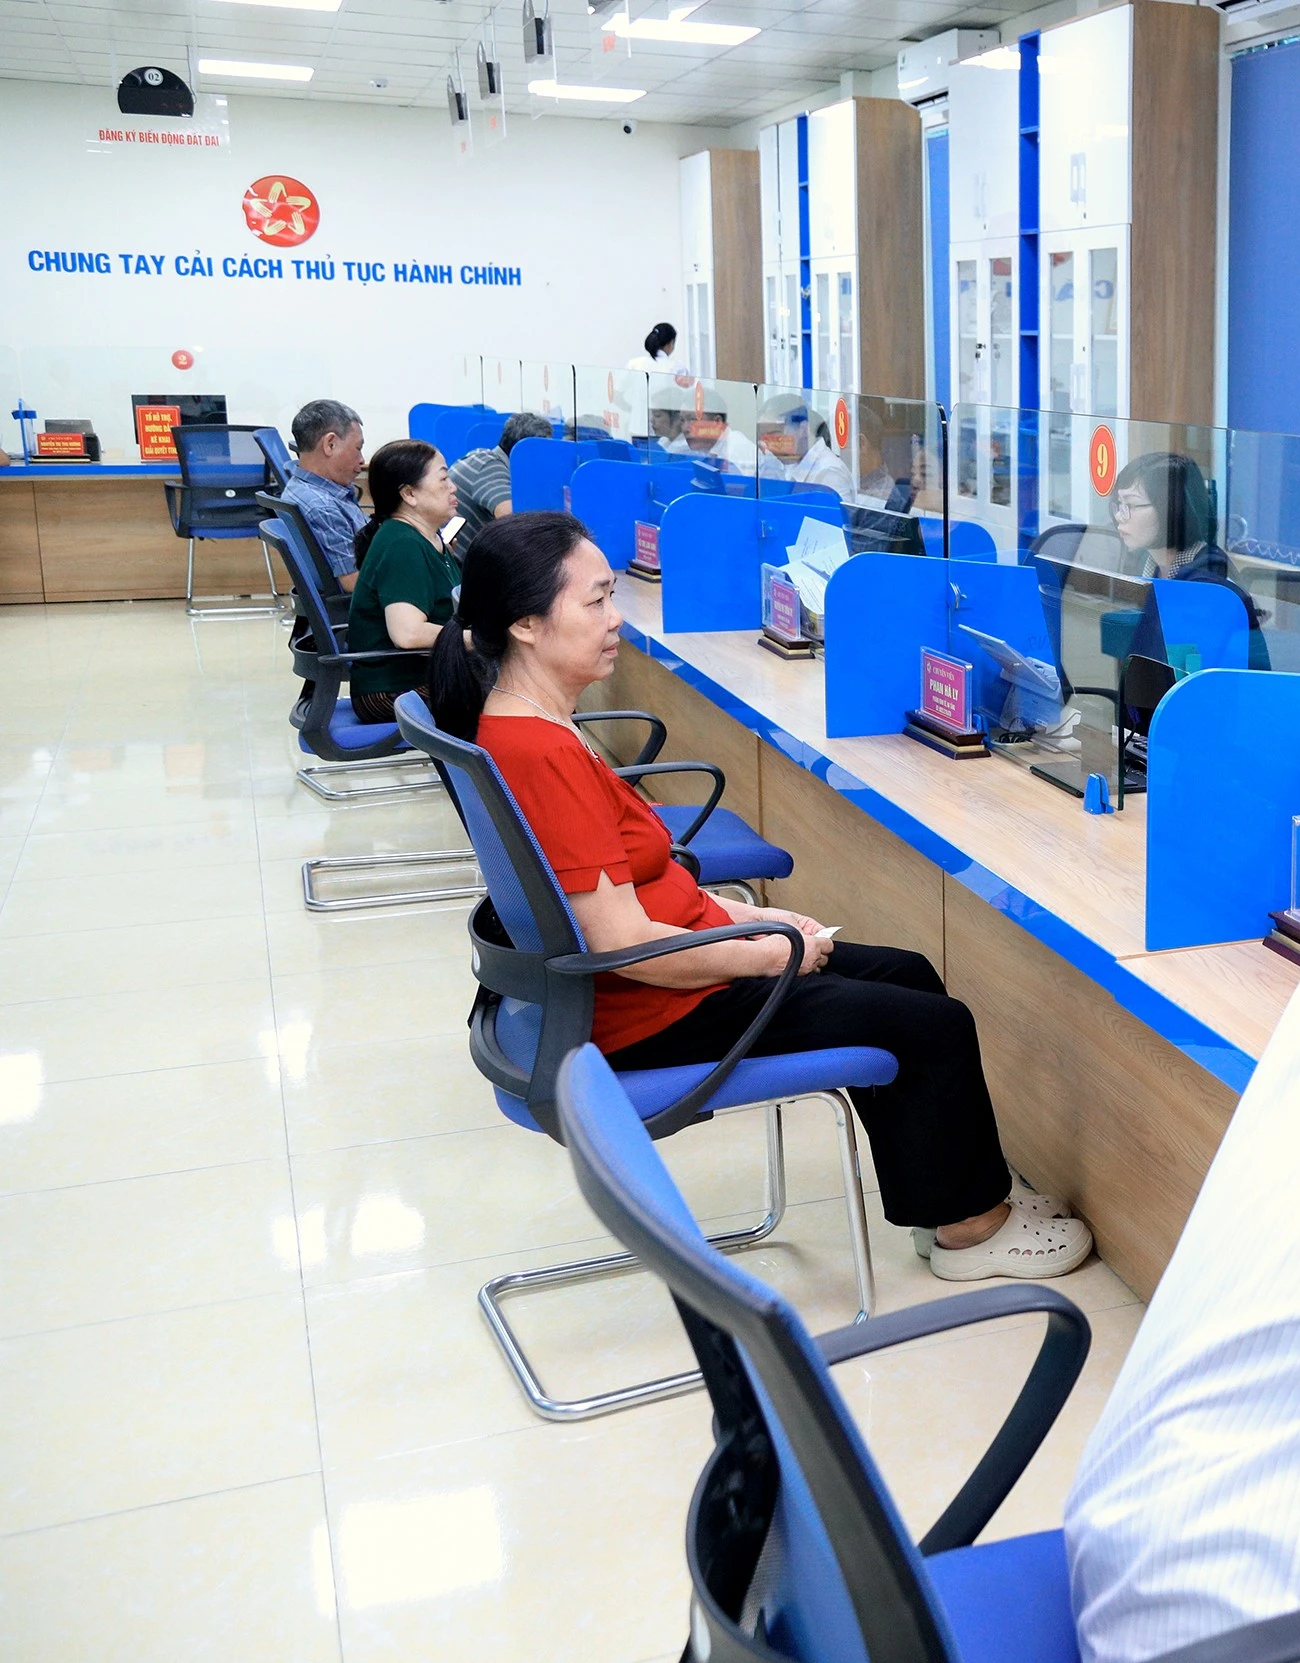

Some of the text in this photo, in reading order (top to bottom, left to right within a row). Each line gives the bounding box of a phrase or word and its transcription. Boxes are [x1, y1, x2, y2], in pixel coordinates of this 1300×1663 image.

[148, 73, 160, 81] 02
[126, 129, 136, 142] KÝ
[140, 129, 159, 143] BIẾN
[162, 132, 184, 146] ĐỘNG
[187, 132, 203, 146] ĐẤT
[205, 135, 220, 146] ĐAI
[28, 249, 522, 286] CHUNG TAY CẢI CÁCH THỦ TỤC HÀNH CHÍNH
[839, 411, 845, 436] 8
[1097, 443, 1108, 478] 9
[930, 679, 944, 695] PHAN
[952, 688, 959, 701] LY
